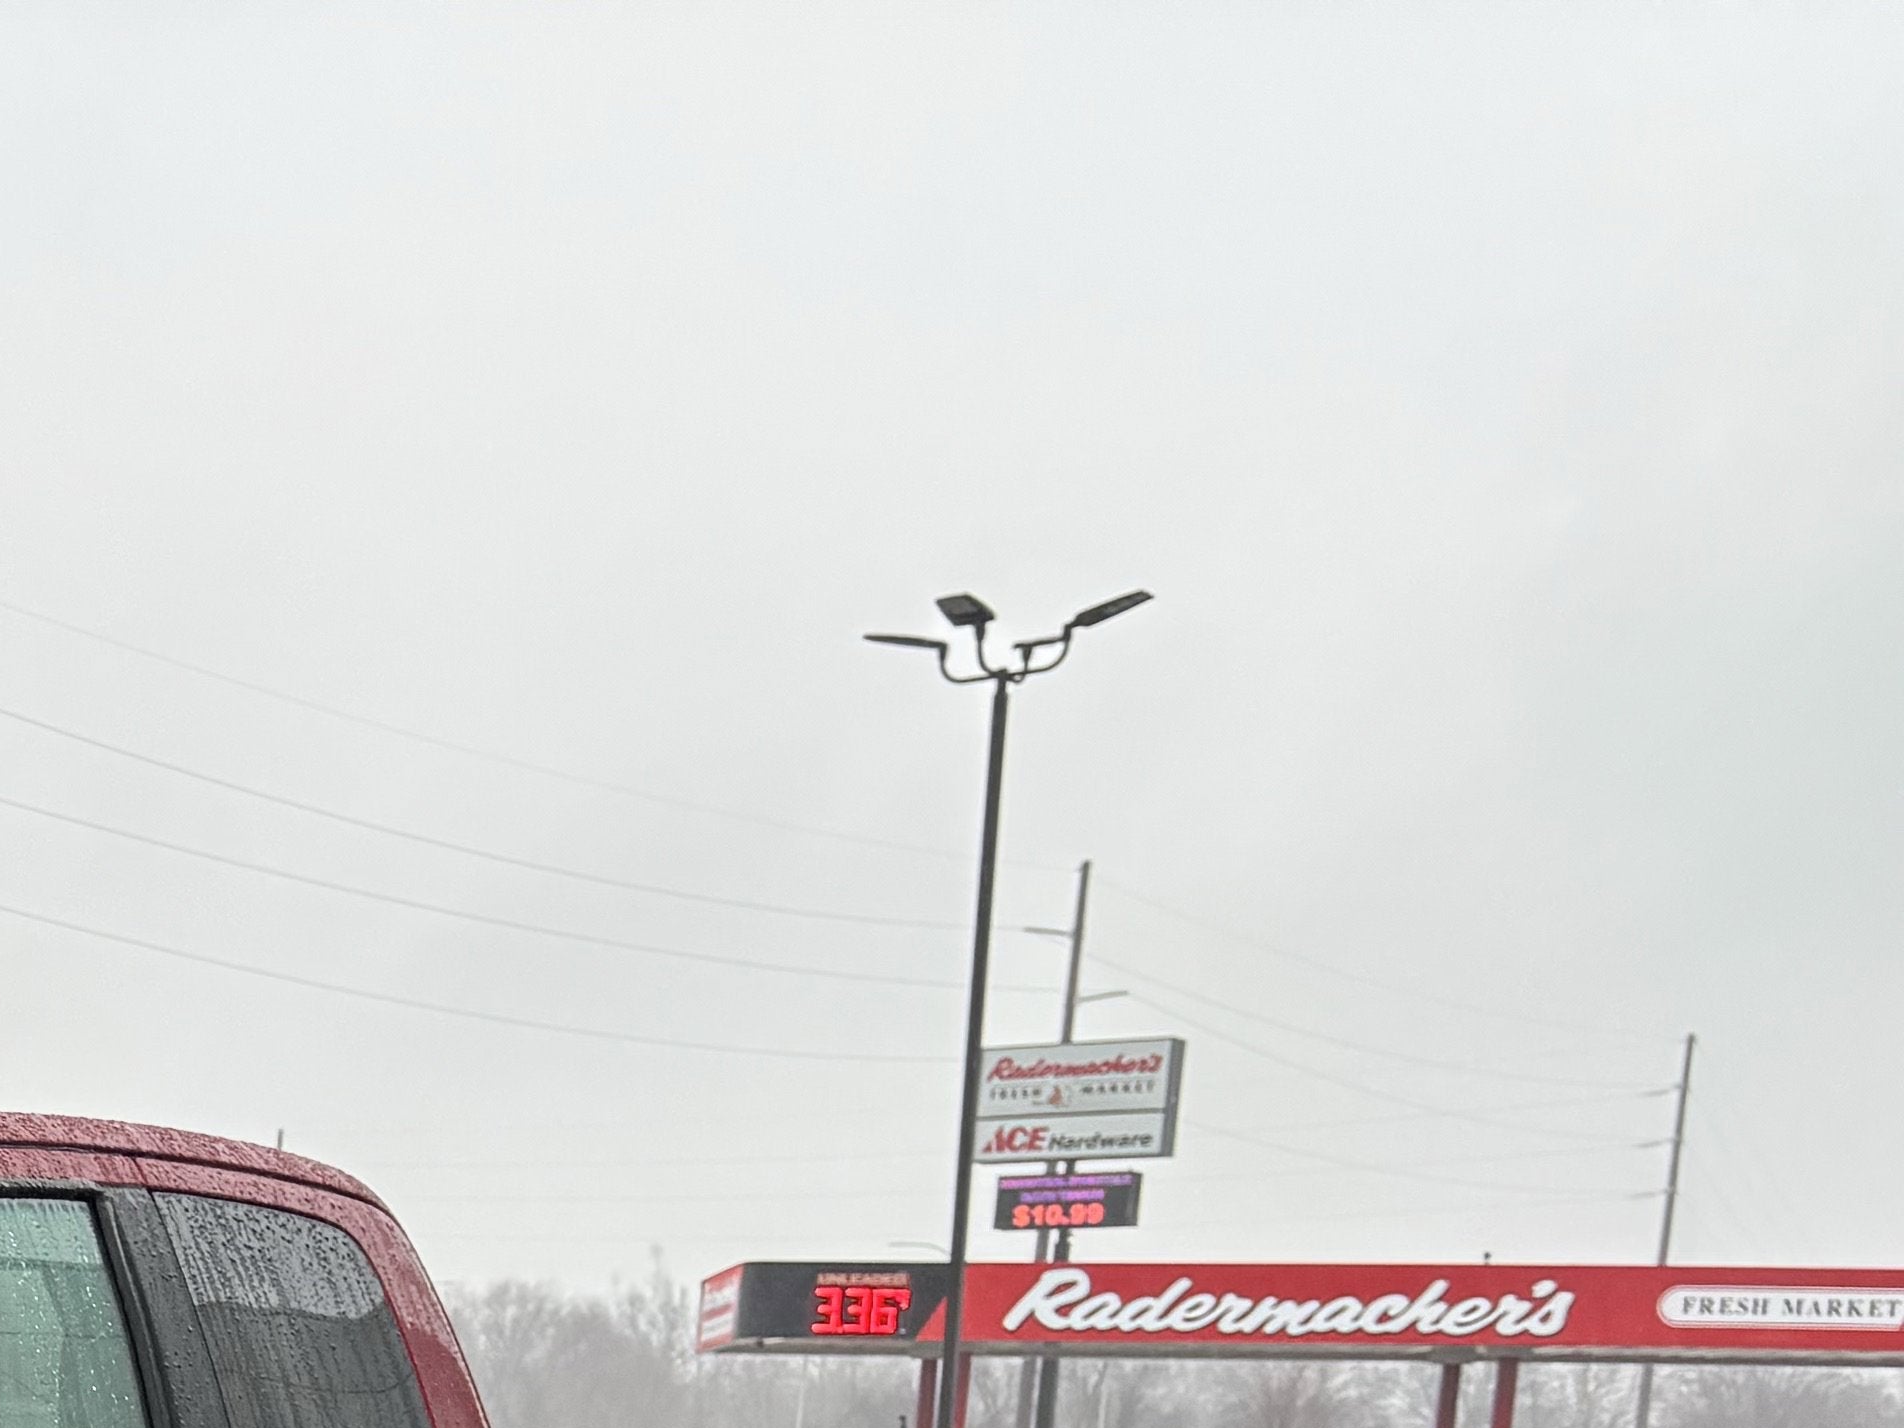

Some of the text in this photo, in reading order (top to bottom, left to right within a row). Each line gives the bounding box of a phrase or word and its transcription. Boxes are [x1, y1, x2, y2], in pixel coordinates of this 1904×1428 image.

[983, 1125, 1153, 1153] ACE Hardware
[1002, 1268, 1576, 1337] Radermacher's
[1682, 1296, 1904, 1318] FRESH MARKET
